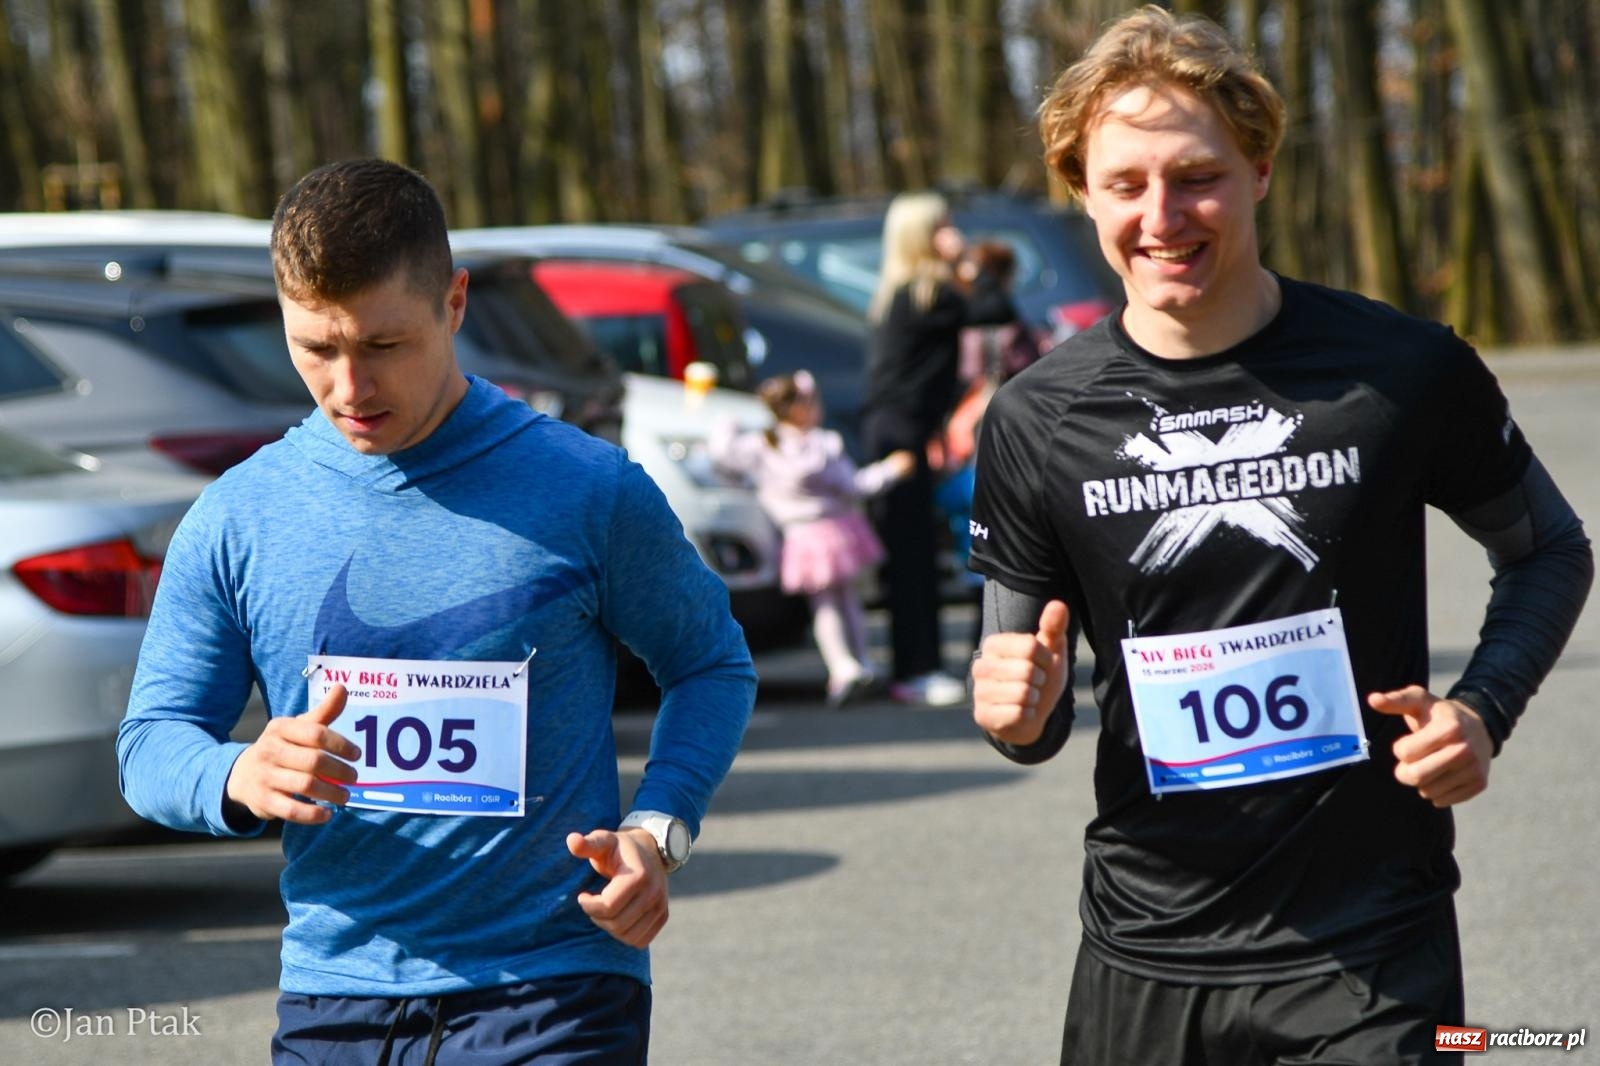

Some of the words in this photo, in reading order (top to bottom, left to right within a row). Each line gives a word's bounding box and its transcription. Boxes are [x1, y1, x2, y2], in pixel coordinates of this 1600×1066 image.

[1158, 404, 1264, 432] SMMASH
[1082, 446, 1361, 517] RUNMAGEDDON
[1140, 649, 1165, 664] XIV
[1218, 624, 1327, 655] TWARDZIELA
[324, 668, 352, 684] XIV
[406, 673, 511, 689] TWARDZIELA
[372, 690, 398, 700] 2026
[1178, 674, 1309, 744] 106
[354, 714, 478, 774] 105
